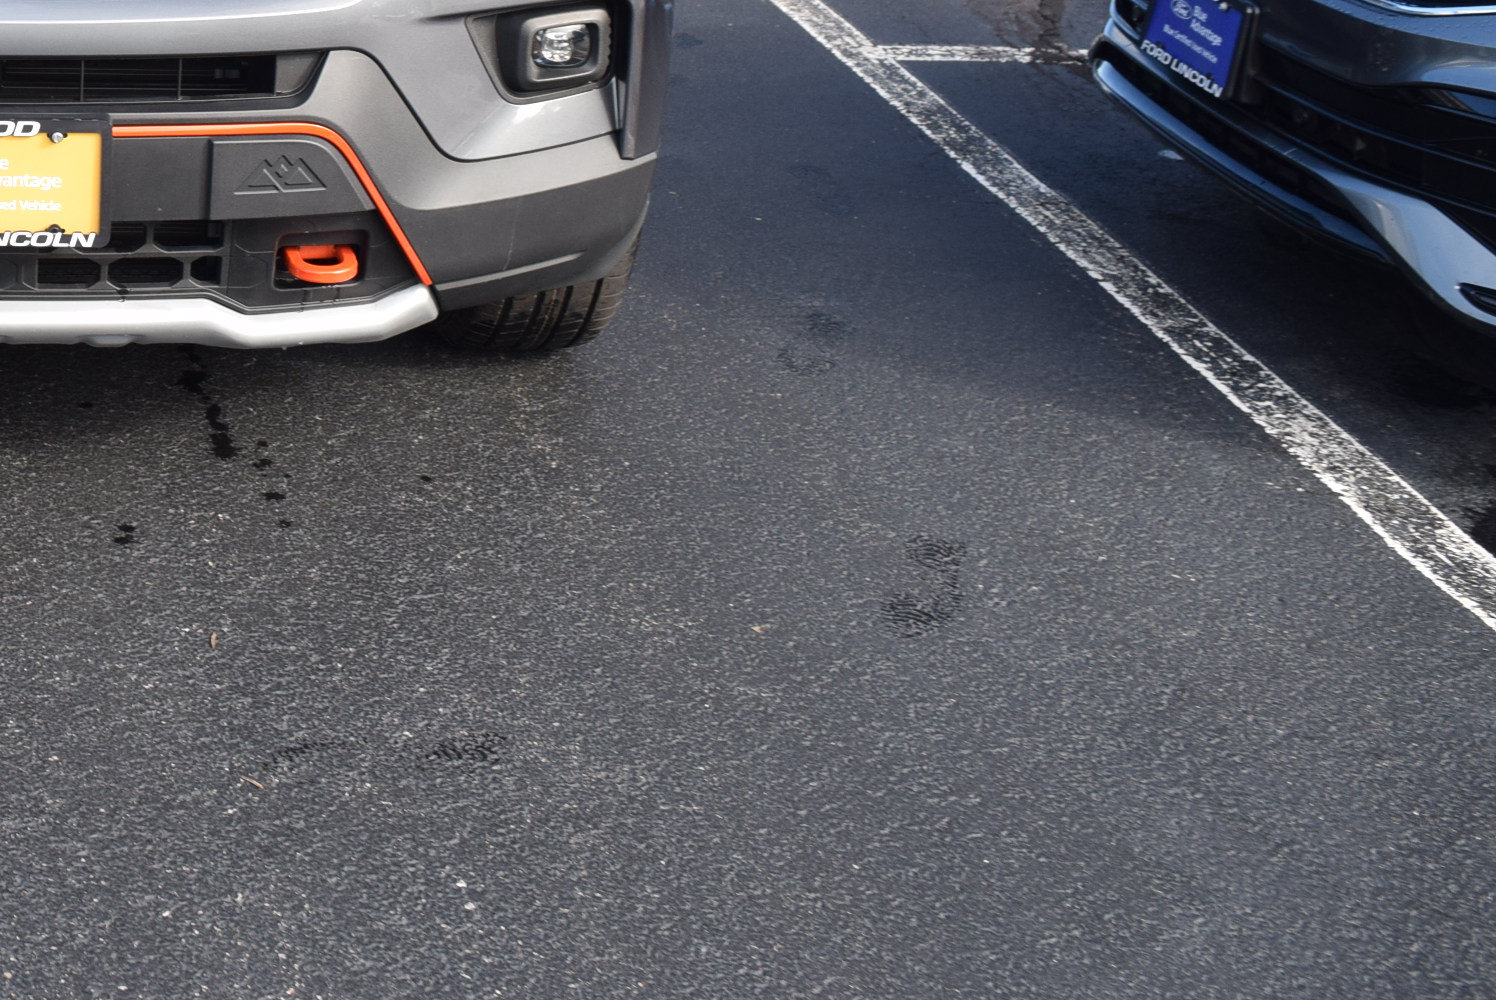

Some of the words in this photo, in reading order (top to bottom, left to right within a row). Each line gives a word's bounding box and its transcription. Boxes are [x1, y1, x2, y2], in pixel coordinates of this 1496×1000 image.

[1140, 40, 1173, 65] FORD
[1170, 58, 1223, 98] LINCOLN
[19, 200, 61, 211] Vehicle
